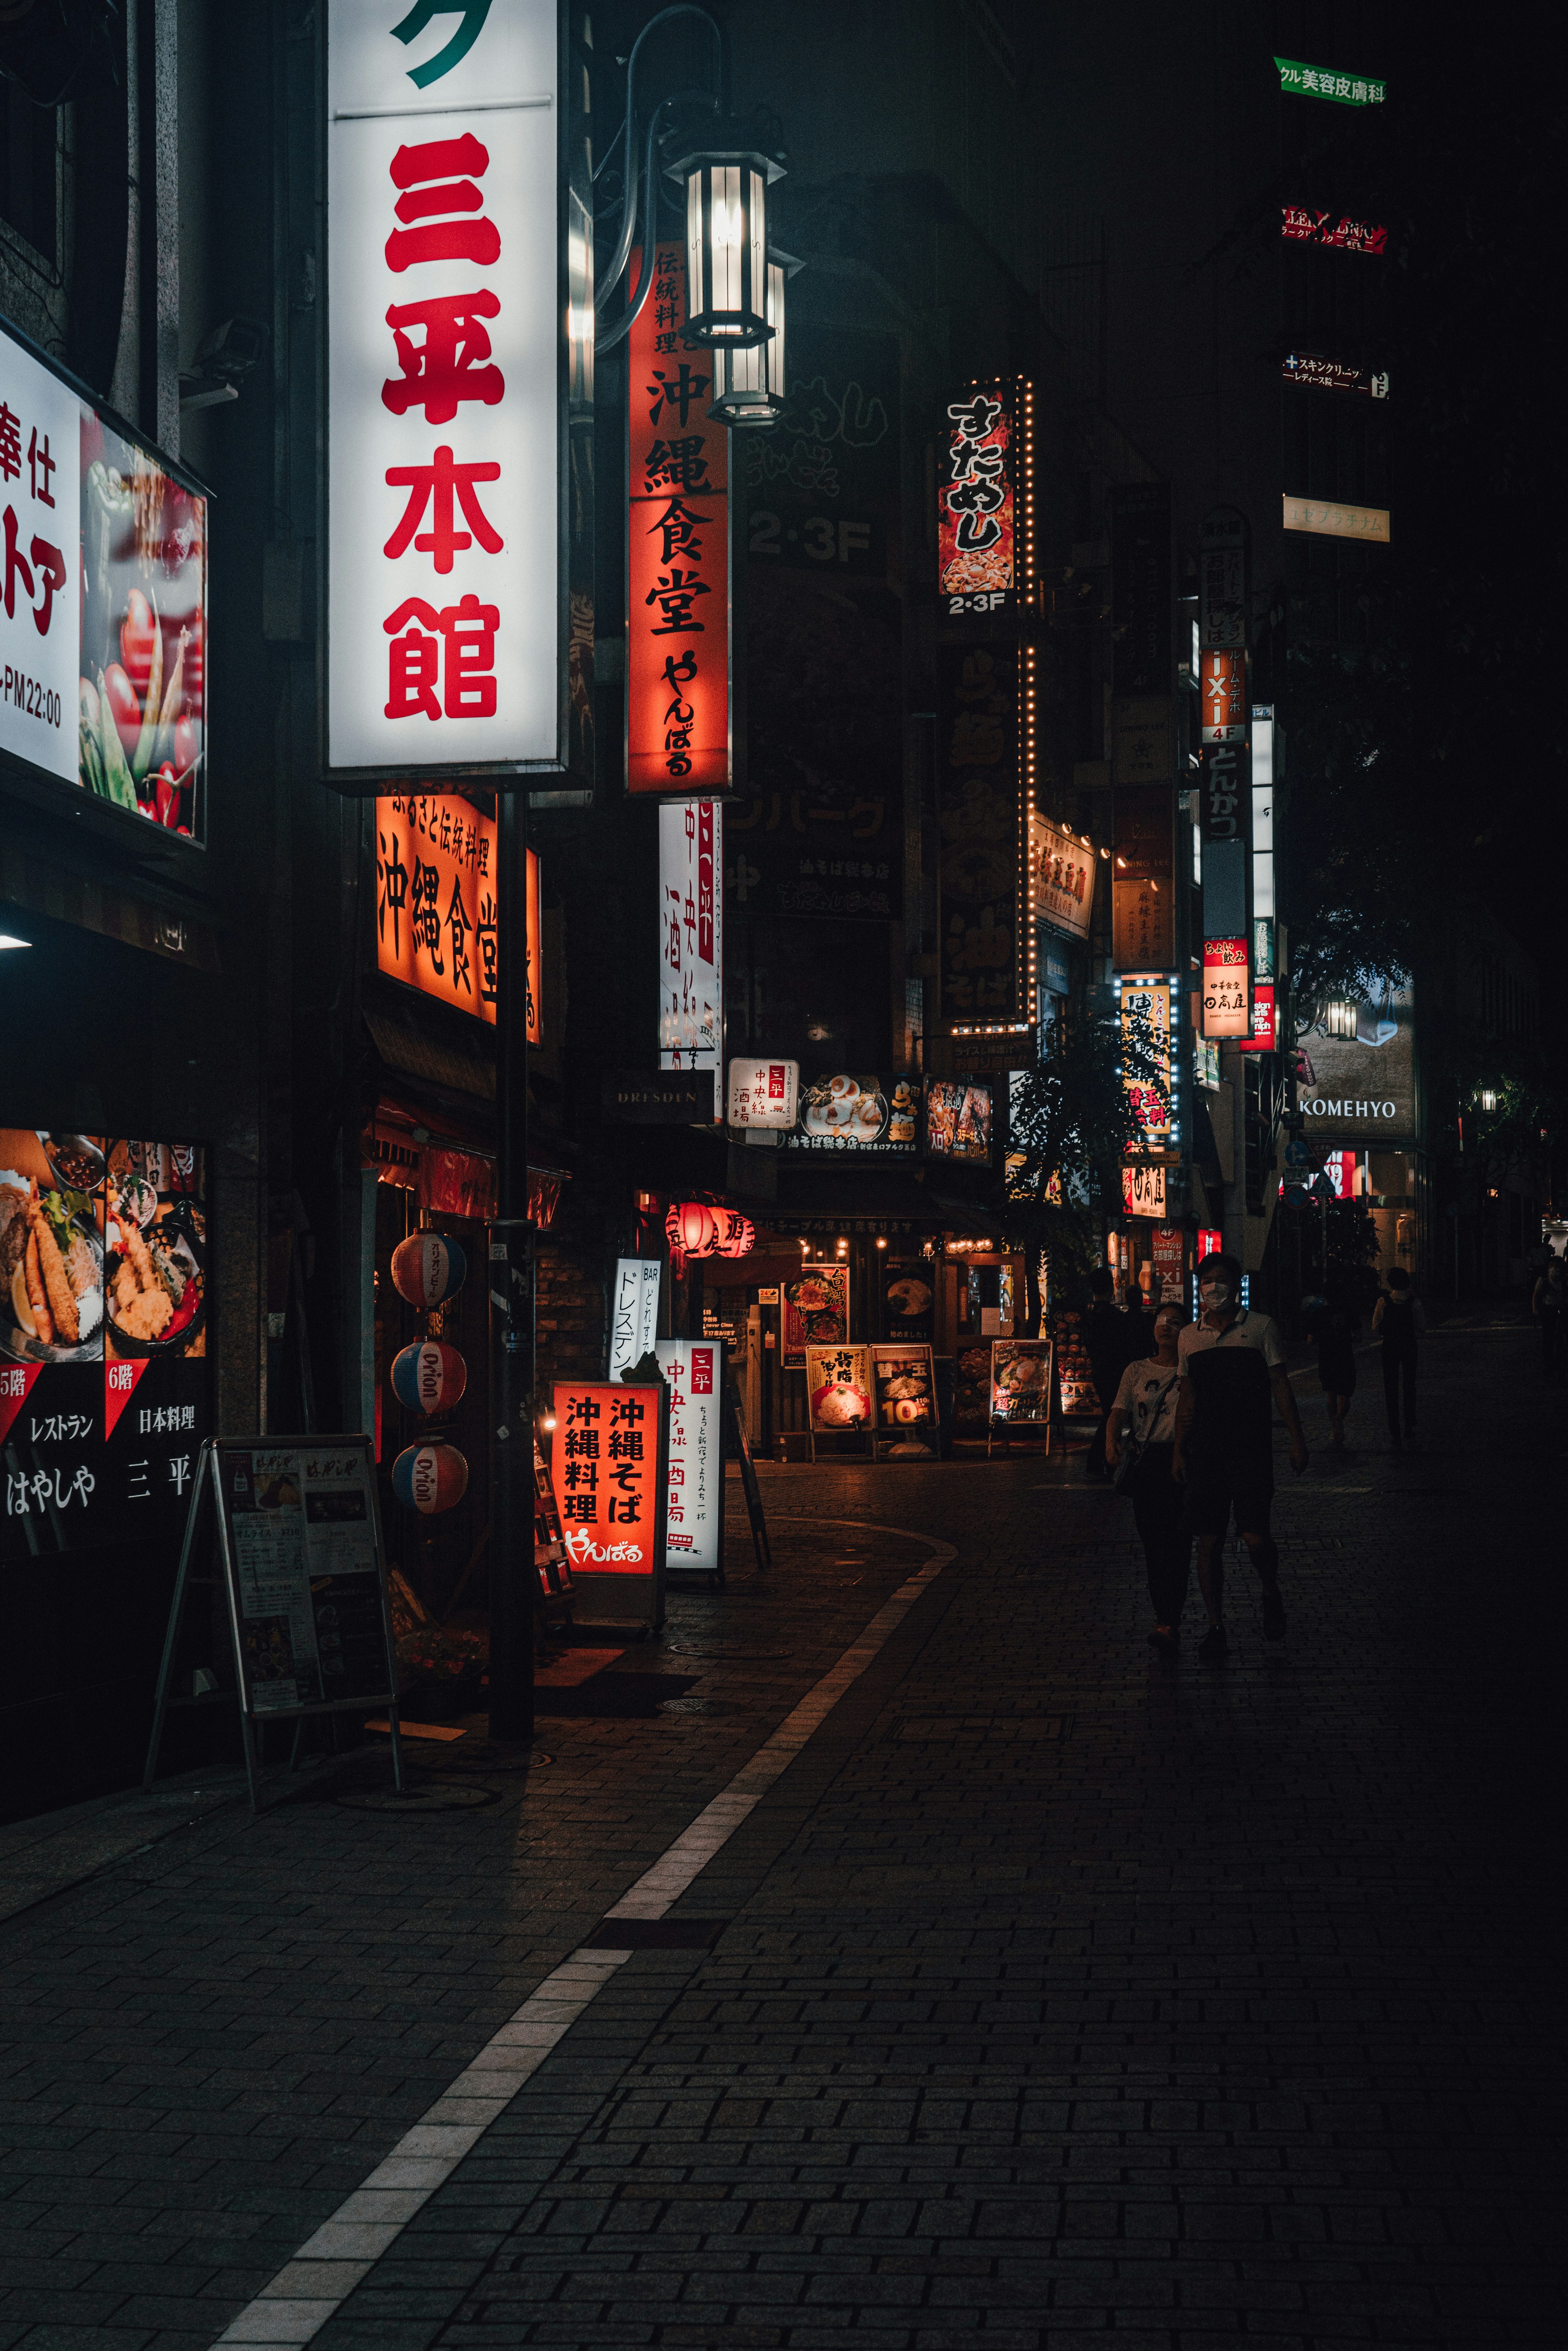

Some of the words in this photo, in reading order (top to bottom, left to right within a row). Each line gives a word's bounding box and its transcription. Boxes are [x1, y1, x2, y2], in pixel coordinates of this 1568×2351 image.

[654, 252, 679, 354] 伝統料理
[1299, 359, 1364, 379] スキンクリニッ
[381, 131, 505, 722] 三平本館
[646, 363, 713, 636] 沖縄食堂
[660, 651, 697, 776] やんばる
[1212, 727, 1235, 740] 4F
[1208, 746, 1239, 839] とんかつ
[377, 831, 497, 1004] 沖縄食堂
[1205, 942, 1234, 955] ちょい
[1223, 950, 1245, 964] 飲み
[1256, 921, 1267, 975] お部屋探しは
[1204, 993, 1247, 1009] 日高屋
[1210, 980, 1241, 991] 中華食堂
[751, 1069, 766, 1115] 中央線
[769, 1069, 783, 1096] 三平
[733, 1088, 750, 1123] 酒場
[1299, 1099, 1396, 1118] KOMEHYO
[788, 1135, 858, 1150] 油そば総本店
[431, 1243, 441, 1299] オリオンビール
[643, 1267, 658, 1283] BAR
[613, 1271, 637, 1370] ドレスデン
[107, 1364, 134, 1390] 6階
[422, 1353, 442, 1397] Orion
[691, 1353, 711, 1392] 三平
[820, 1360, 836, 1388] 油そば
[835, 1350, 853, 1384] 背脂
[877, 1362, 928, 1378] 替玉
[31, 1413, 94, 1443] レストラン
[139, 1404, 196, 1435] 日本料理
[127, 1453, 191, 1500] 三平
[563, 1396, 601, 1524] 沖縄料理
[608, 1397, 645, 1524] 沖縄そば
[696, 1405, 707, 1521] ちょっと新宿でよりみち一杯
[7, 1464, 96, 1516] はやしや
[416, 1458, 437, 1502] Orion
[564, 1527, 643, 1564] やんばる
